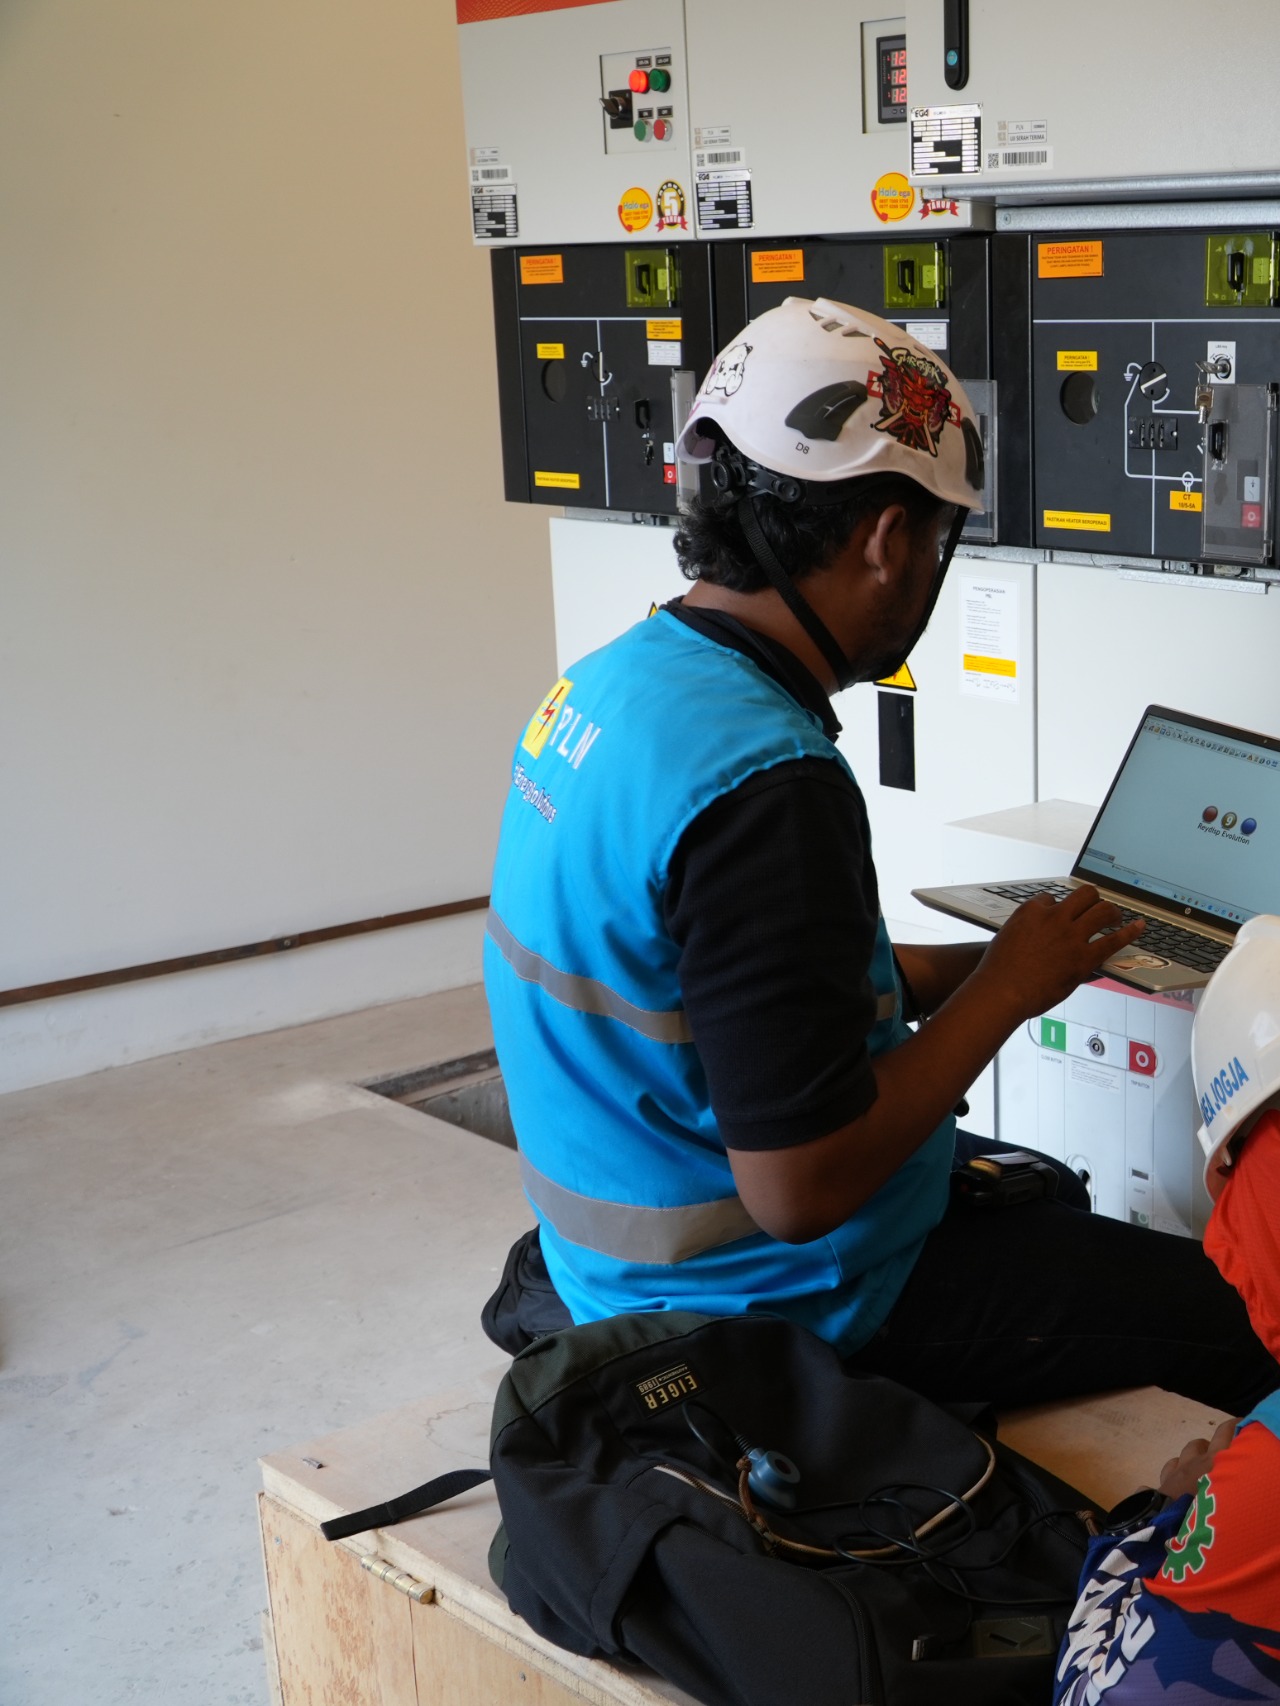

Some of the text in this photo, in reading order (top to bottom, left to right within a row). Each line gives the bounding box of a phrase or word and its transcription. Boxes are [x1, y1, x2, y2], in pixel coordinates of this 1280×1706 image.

[879, 187, 898, 197] Halo
[664, 191, 679, 215] 5
[927, 200, 951, 210] TAHUN
[1047, 245, 1089, 255] PERINGATAN
[758, 254, 793, 262] PERINGATAN
[795, 441, 810, 455] D8
[548, 703, 602, 770] PLN
[1197, 822, 1250, 845] Reydisp Evolution
[1210, 1056, 1250, 1111] JOGJA
[638, 1379, 657, 1393] 1989
[644, 1374, 698, 1410] EIGER
